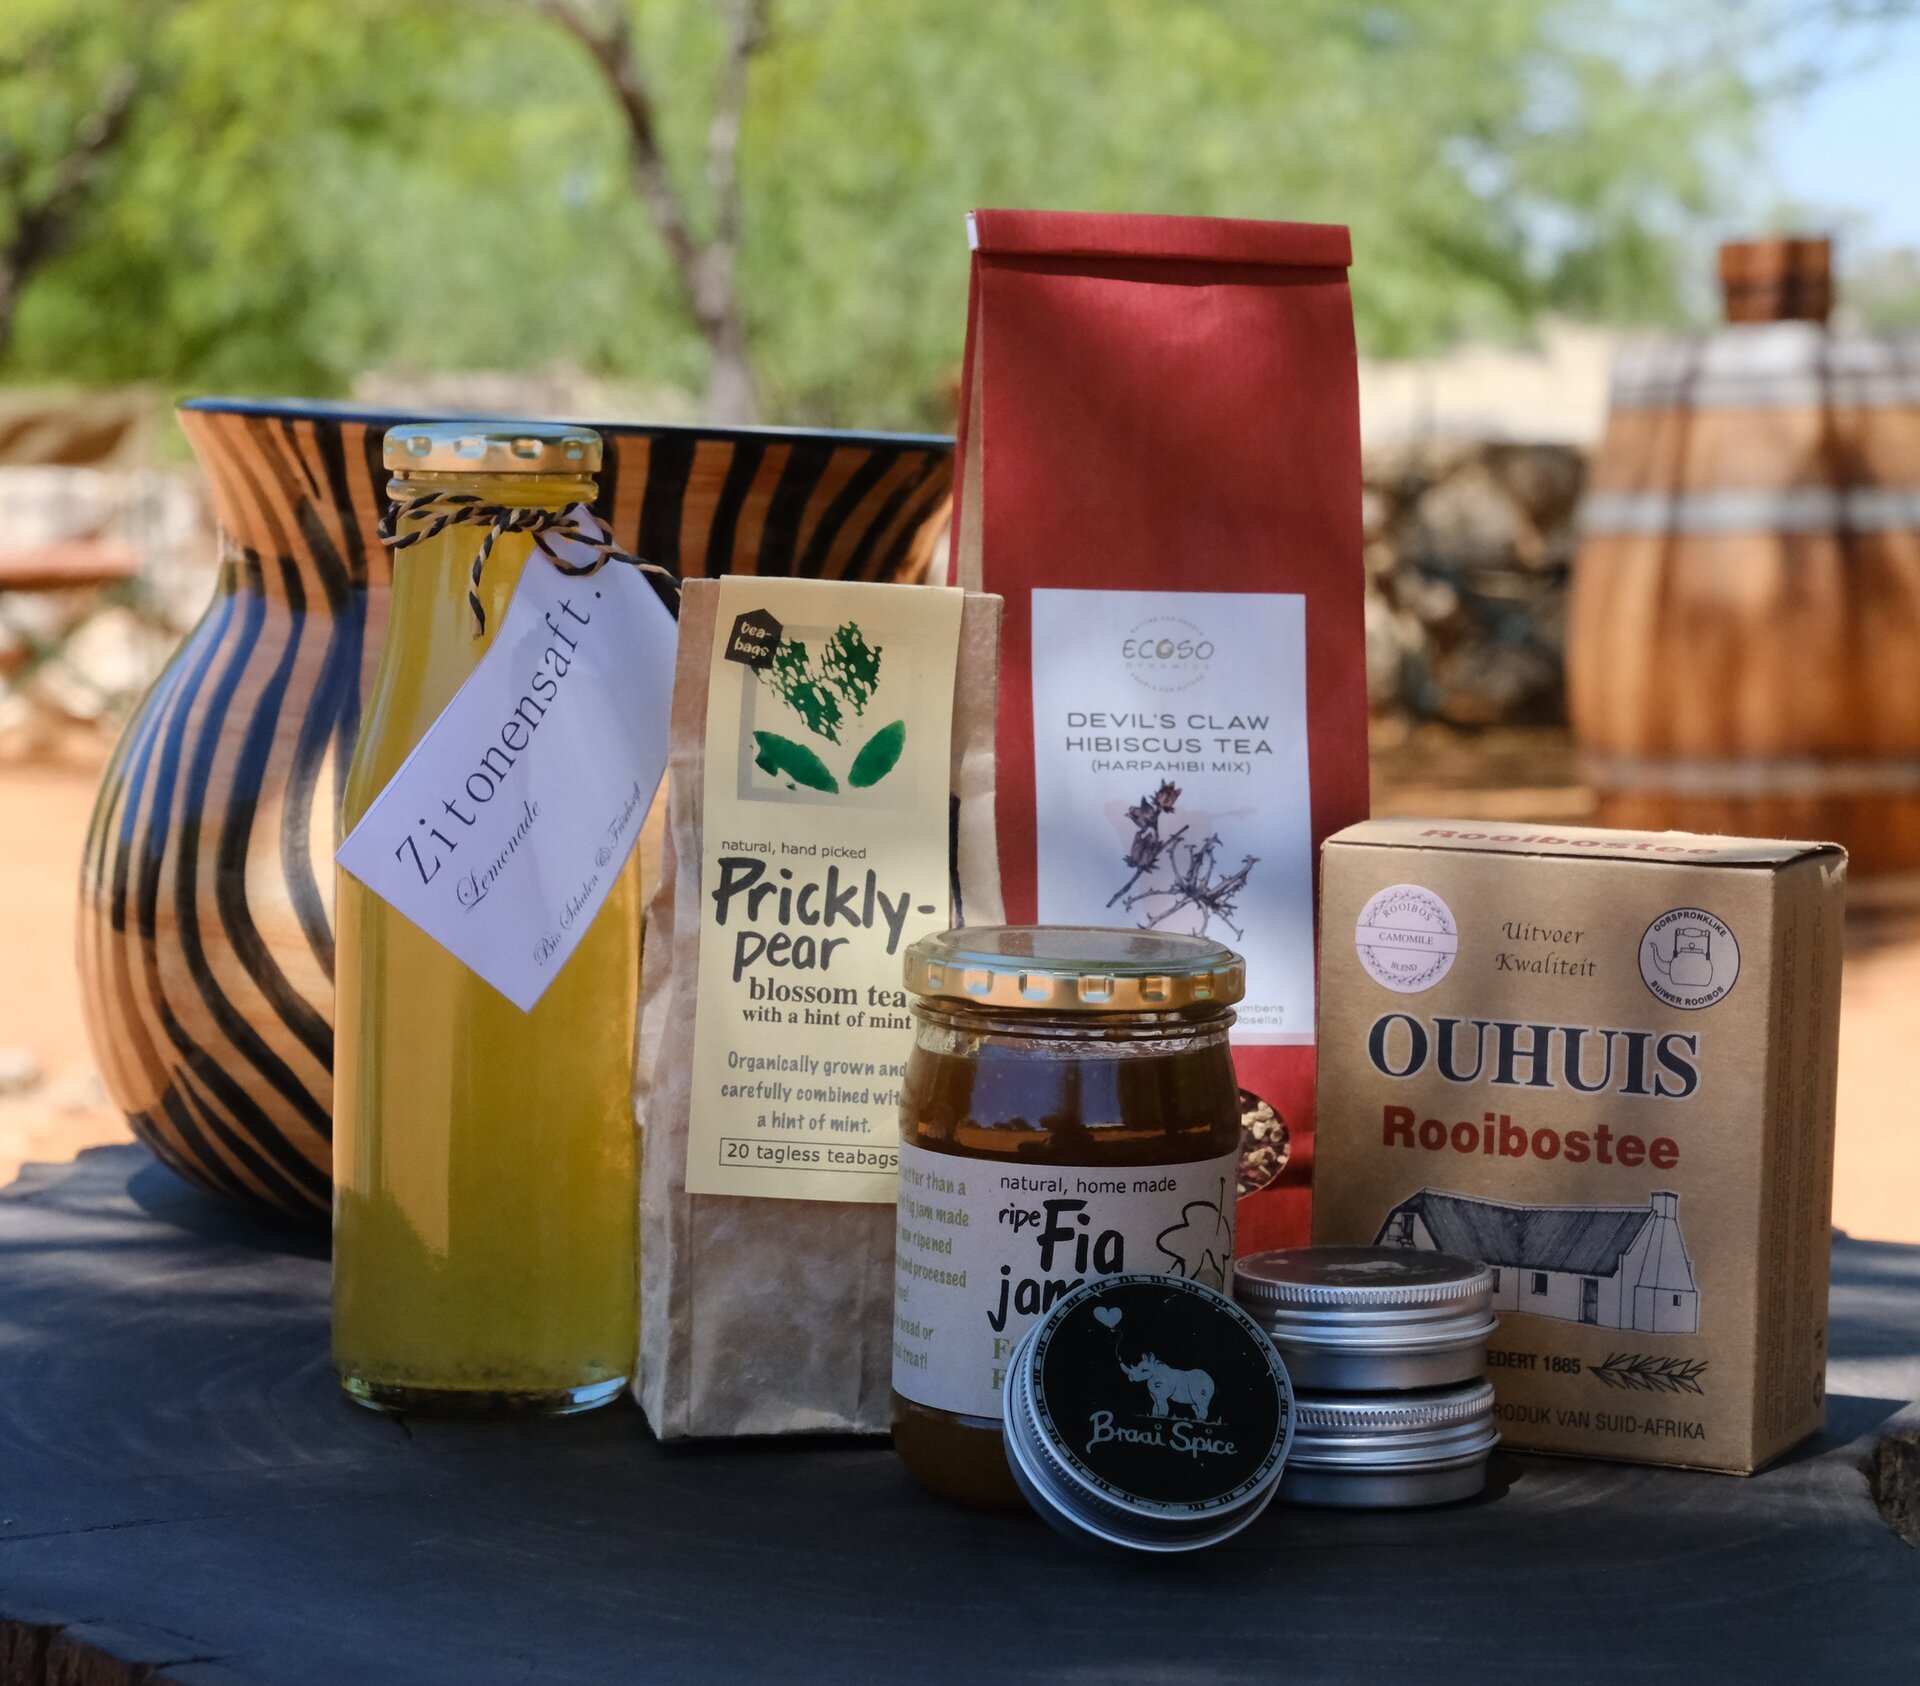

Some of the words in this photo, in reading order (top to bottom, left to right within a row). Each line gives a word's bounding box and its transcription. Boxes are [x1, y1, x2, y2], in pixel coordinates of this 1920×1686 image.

[740, 621, 772, 639] tea-
[734, 637, 770, 659] bags
[1122, 638, 1215, 660] ECOSO
[1067, 712, 1176, 730] DEVIL'S
[1187, 714, 1270, 730] CLAW
[1066, 736, 1202, 754] HIBISCUS
[1213, 739, 1273, 755] TEA
[1091, 759, 1205, 774] (HARPAHIBI
[1212, 761, 1252, 775] MIX)
[721, 839, 776, 855] natural,
[781, 842, 817, 856] hand
[821, 845, 867, 859] picked
[1419, 828, 1719, 855] Rooibostee
[456, 799, 541, 913] Lemonade
[711, 857, 936, 955] Prickly-
[1382, 902, 1432, 921] ROOIBOS
[1502, 921, 1585, 944] Uitvoer
[1653, 911, 1728, 938] OORSPRONKLIKE
[534, 933, 562, 966] Bio
[1378, 932, 1434, 945] CAMOMILE
[732, 930, 850, 983] pear
[1390, 961, 1418, 972] BLEND
[1495, 952, 1597, 977] Kwaliteit
[749, 977, 858, 1006] blossom
[868, 986, 907, 1008] tea
[1650, 980, 1682, 1005] SUIWER
[1684, 985, 1725, 1006] ROOIBOS
[742, 1006, 782, 1024] with
[788, 1011, 798, 1024] a
[804, 1008, 840, 1026] hint
[846, 1012, 866, 1028] of
[869, 1013, 912, 1030] mint
[1236, 1004, 1285, 1013] umbens
[728, 1051, 819, 1075] Organically
[824, 1061, 875, 1077] grown
[879, 1062, 907, 1077] and
[1368, 1013, 1699, 1098] OUHUIS
[721, 1081, 792, 1103] carefully
[797, 1086, 869, 1105] combined
[873, 1089, 900, 1106] wit
[757, 1114, 766, 1128] a
[772, 1111, 805, 1129] hint
[809, 1113, 826, 1131] of
[830, 1116, 871, 1133] mint.
[1382, 1105, 1680, 1170] Rooibostee
[727, 1143, 749, 1159] 20
[757, 1145, 820, 1163] tagless
[828, 1149, 898, 1168] teabags
[958, 1182, 966, 1196] a
[1000, 1176, 1068, 1195] natural,
[1077, 1178, 1126, 1193] home
[1133, 1176, 1177, 1193] made
[936, 1208, 969, 1227] made
[999, 1202, 1041, 1233] ripe
[913, 1230, 952, 1255] ripened
[914, 1262, 967, 1288] processed
[1486, 1350, 1537, 1370] EDERT
[1543, 1356, 1581, 1375] 1885
[1493, 1402, 1551, 1425] RODUK
[1556, 1410, 1590, 1430] VAN
[1596, 1412, 1706, 1441] SUID-AFRIKA
[1086, 1410, 1166, 1454] Braai
[1169, 1421, 1238, 1459] Spice
